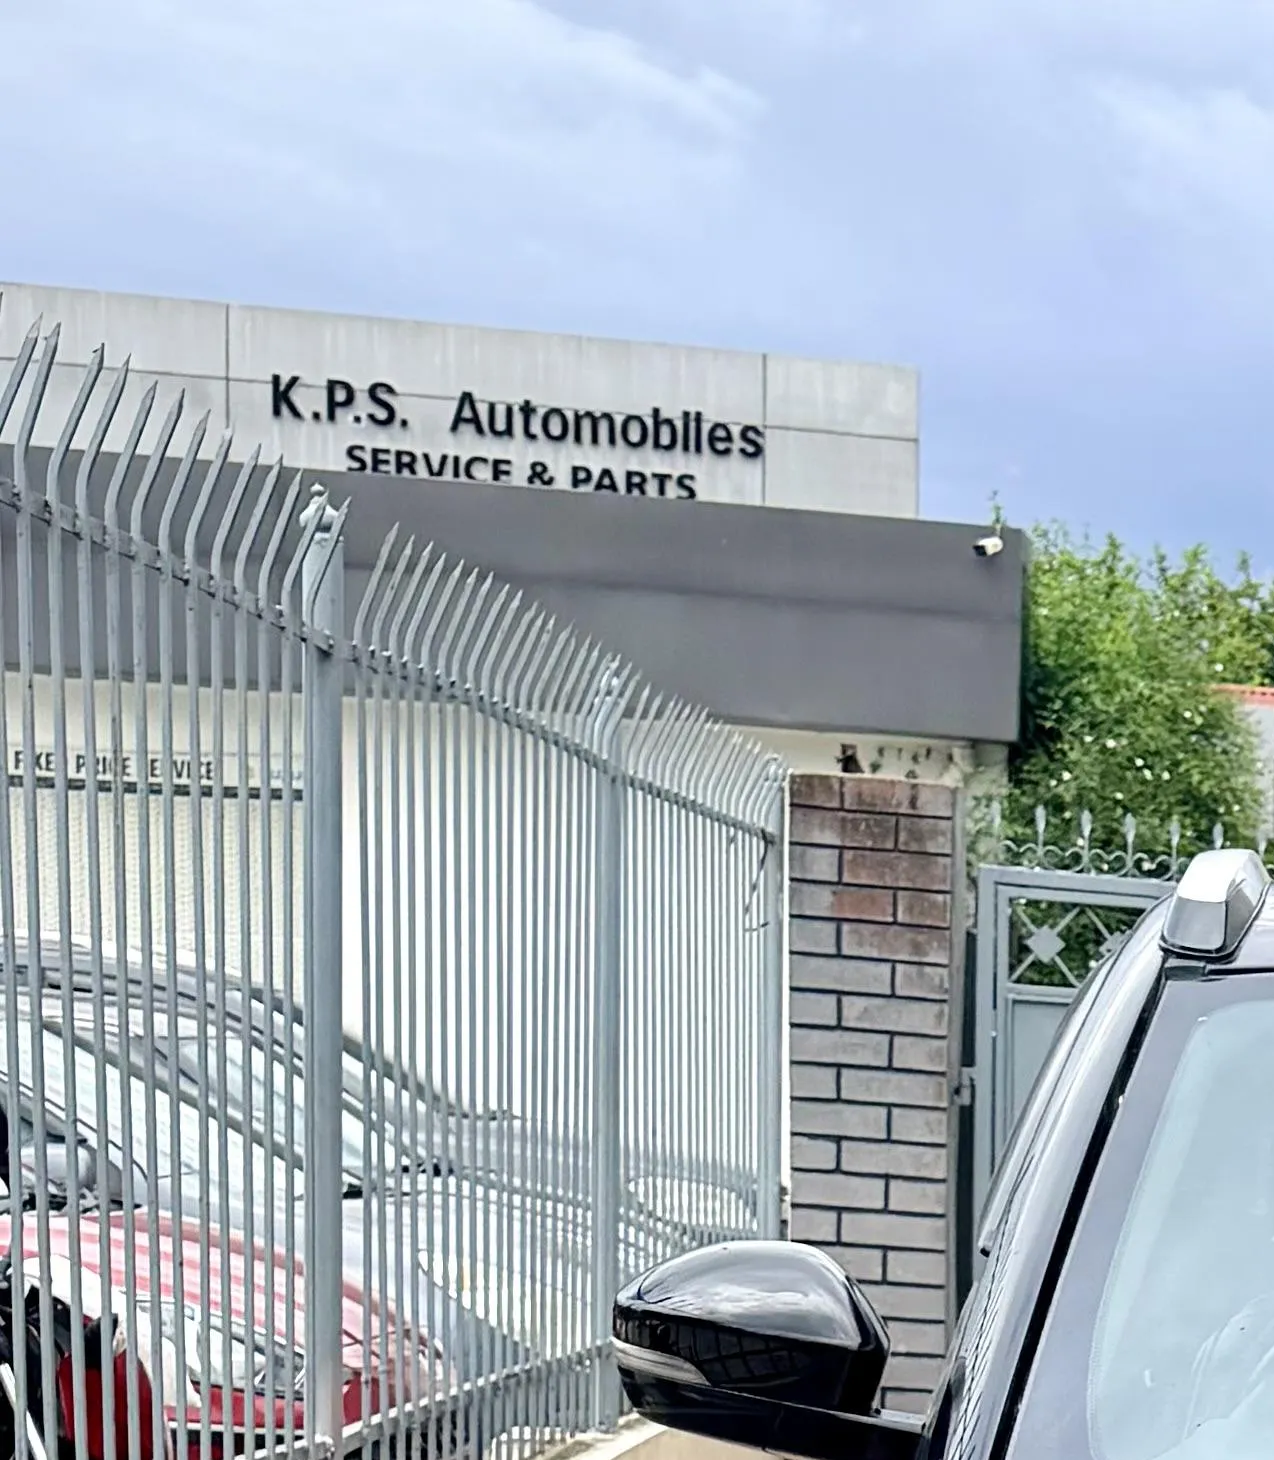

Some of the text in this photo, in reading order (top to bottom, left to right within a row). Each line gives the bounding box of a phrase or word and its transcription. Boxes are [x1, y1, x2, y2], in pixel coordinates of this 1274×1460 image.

[271, 373, 766, 458] K.P.S. Automobiles
[346, 444, 697, 500] SERVICE & PARTS
